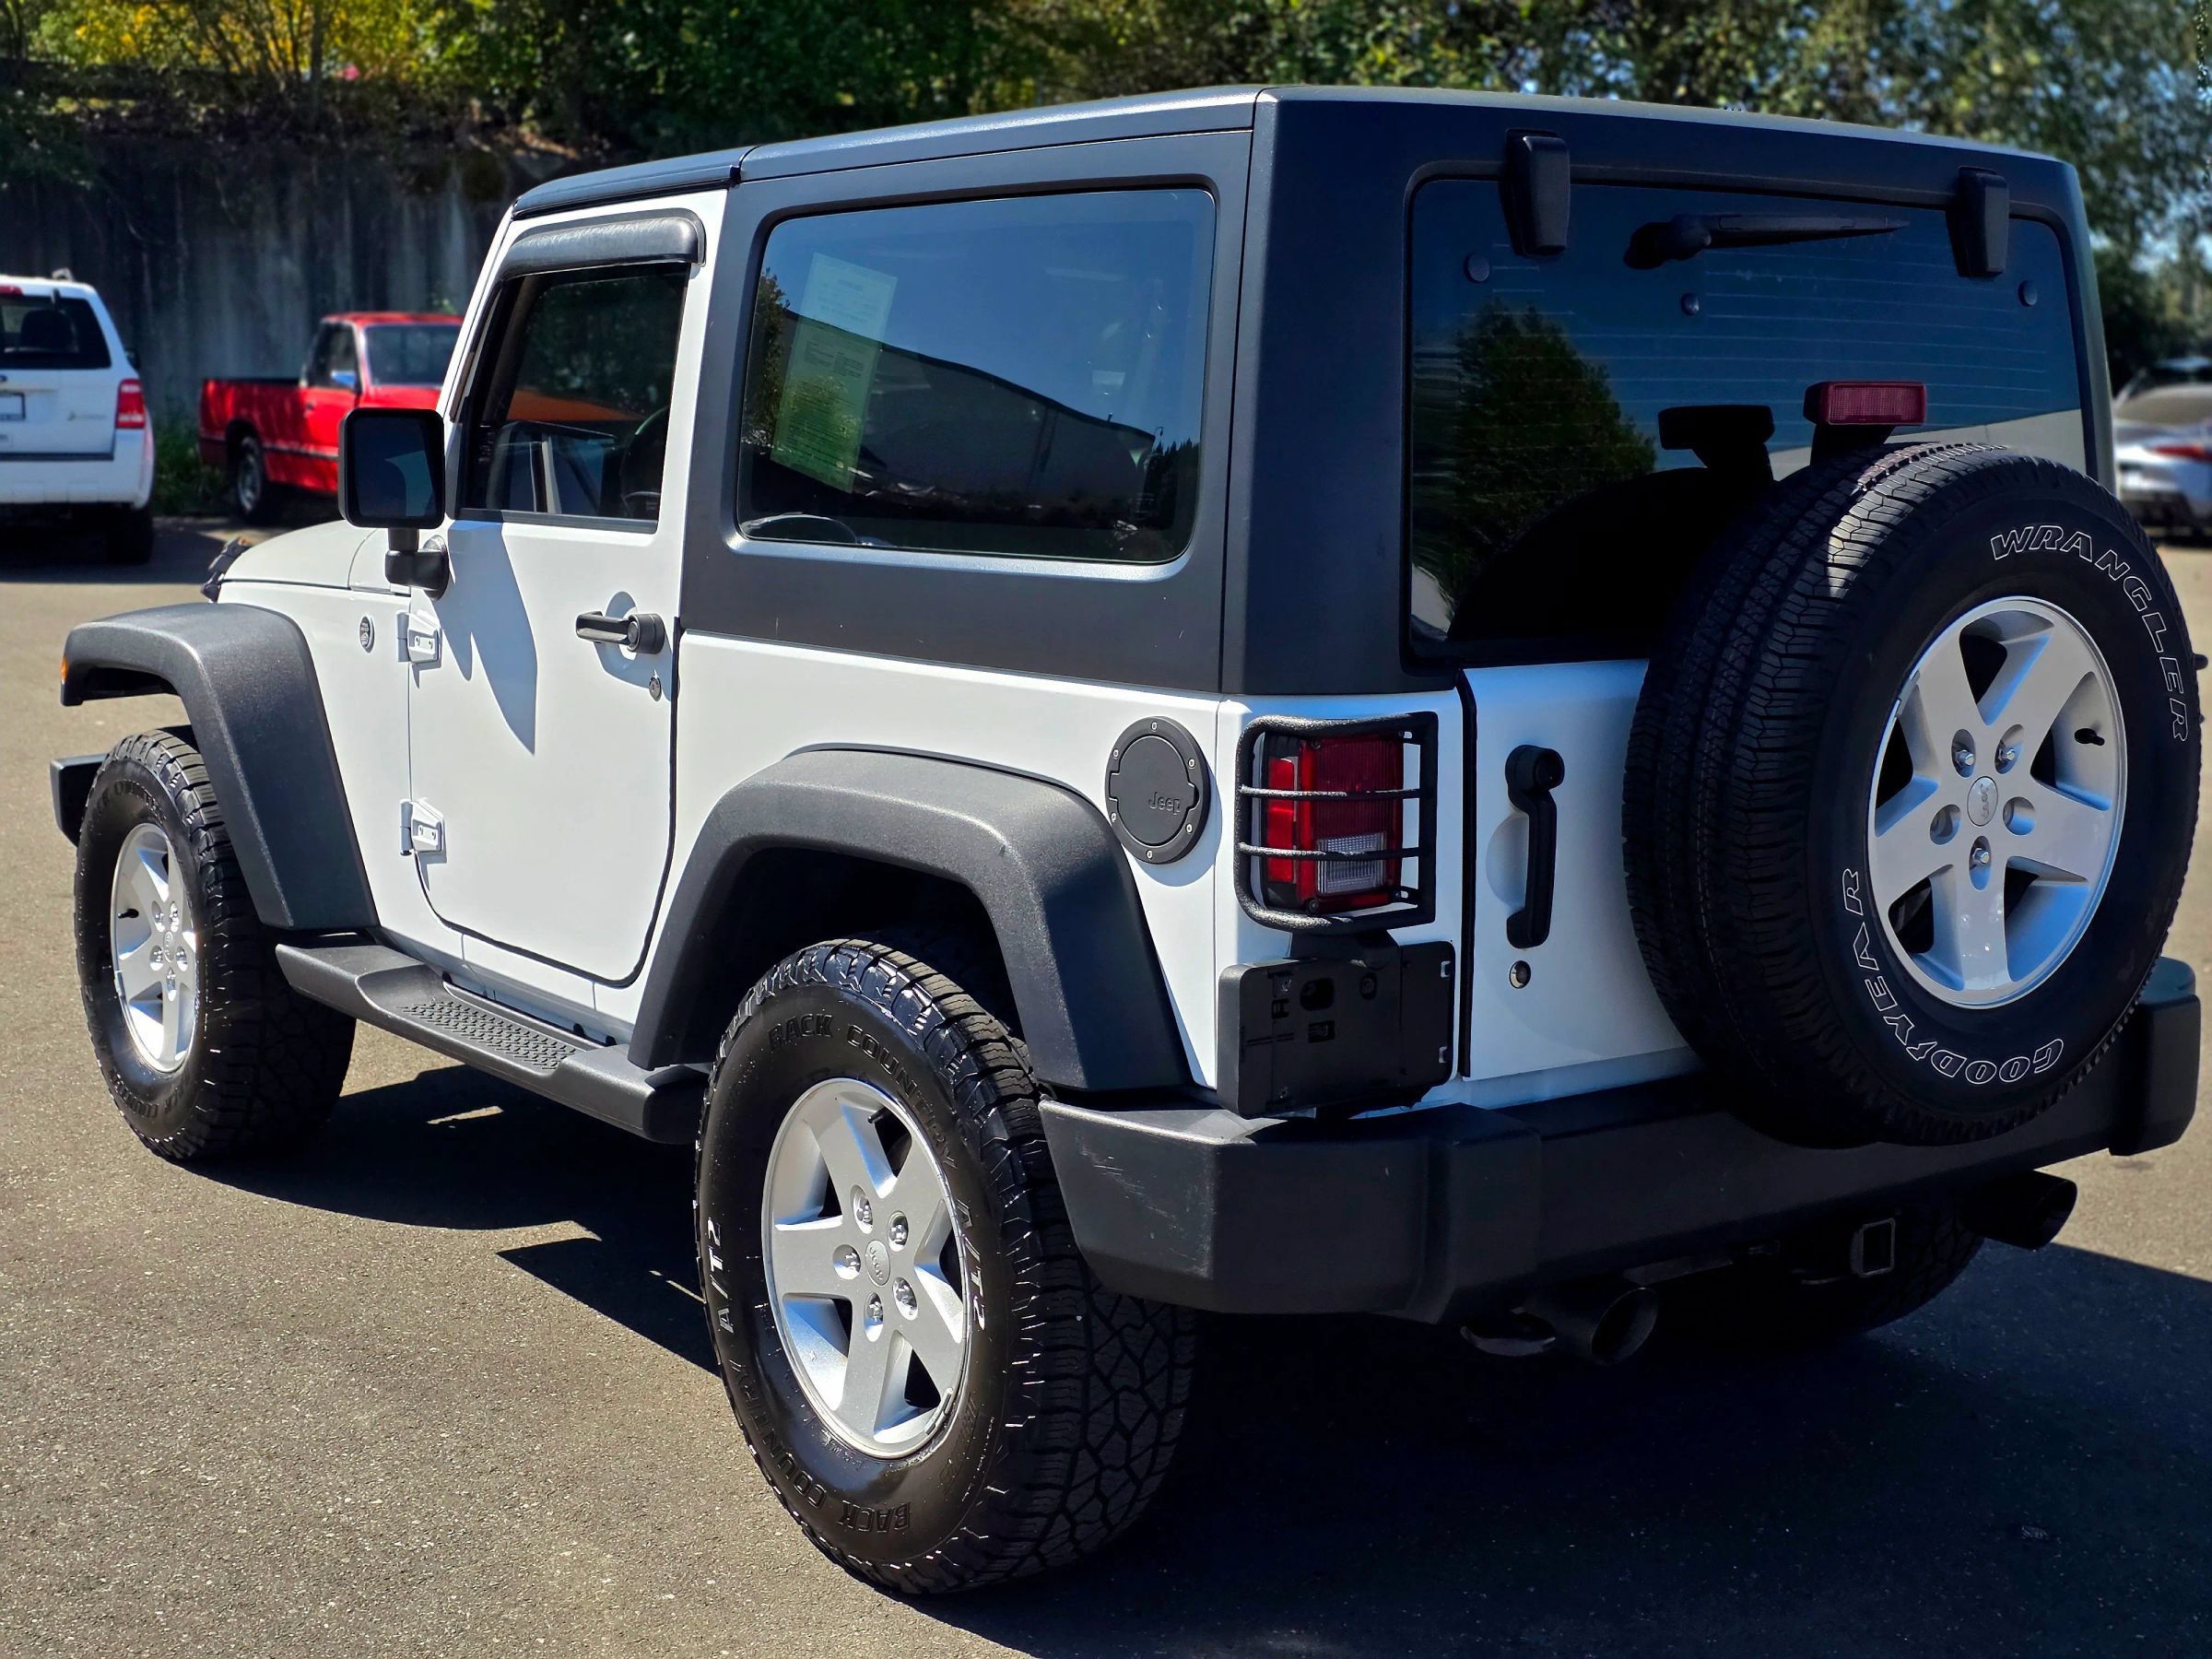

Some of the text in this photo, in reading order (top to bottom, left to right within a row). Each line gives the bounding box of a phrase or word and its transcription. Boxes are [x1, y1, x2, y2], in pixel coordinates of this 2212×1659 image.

[1991, 524, 2188, 742] WRANGLER
[1148, 792, 1181, 816] Jeep
[1842, 868, 2064, 1084] GOODYEAR
[768, 1013, 958, 1169] BACK COUNTRY
[707, 1217, 734, 1334] A/T2
[838, 1500, 911, 1532] BACK
